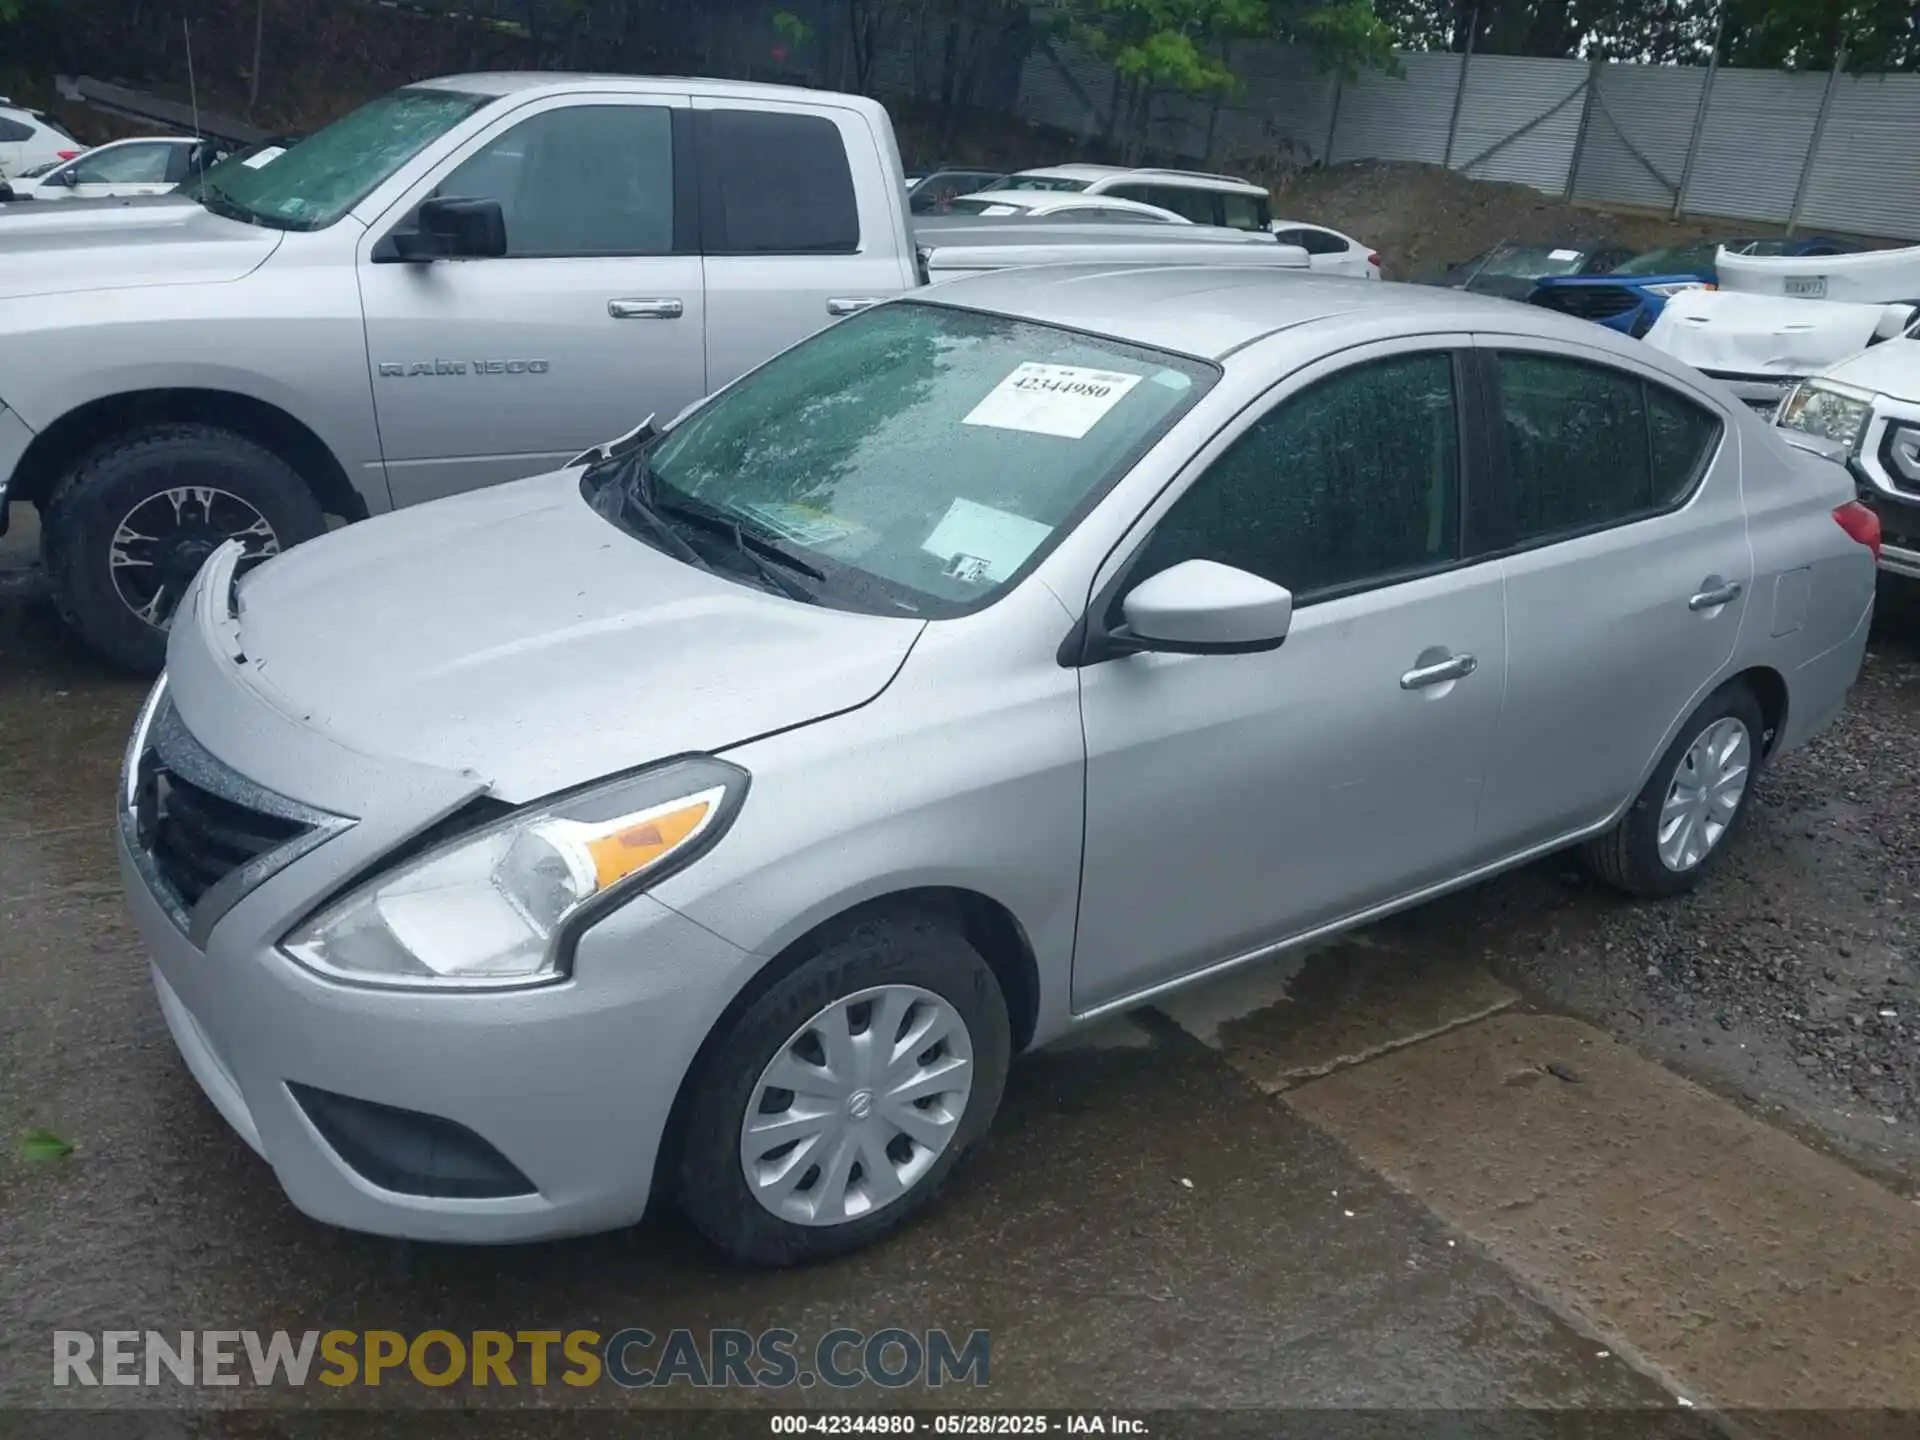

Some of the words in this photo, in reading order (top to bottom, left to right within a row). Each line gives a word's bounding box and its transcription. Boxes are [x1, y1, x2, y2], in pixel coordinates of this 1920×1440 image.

[379, 359, 467, 377] RAM
[473, 358, 550, 375] 1500
[1013, 376, 1112, 398] 42344980
